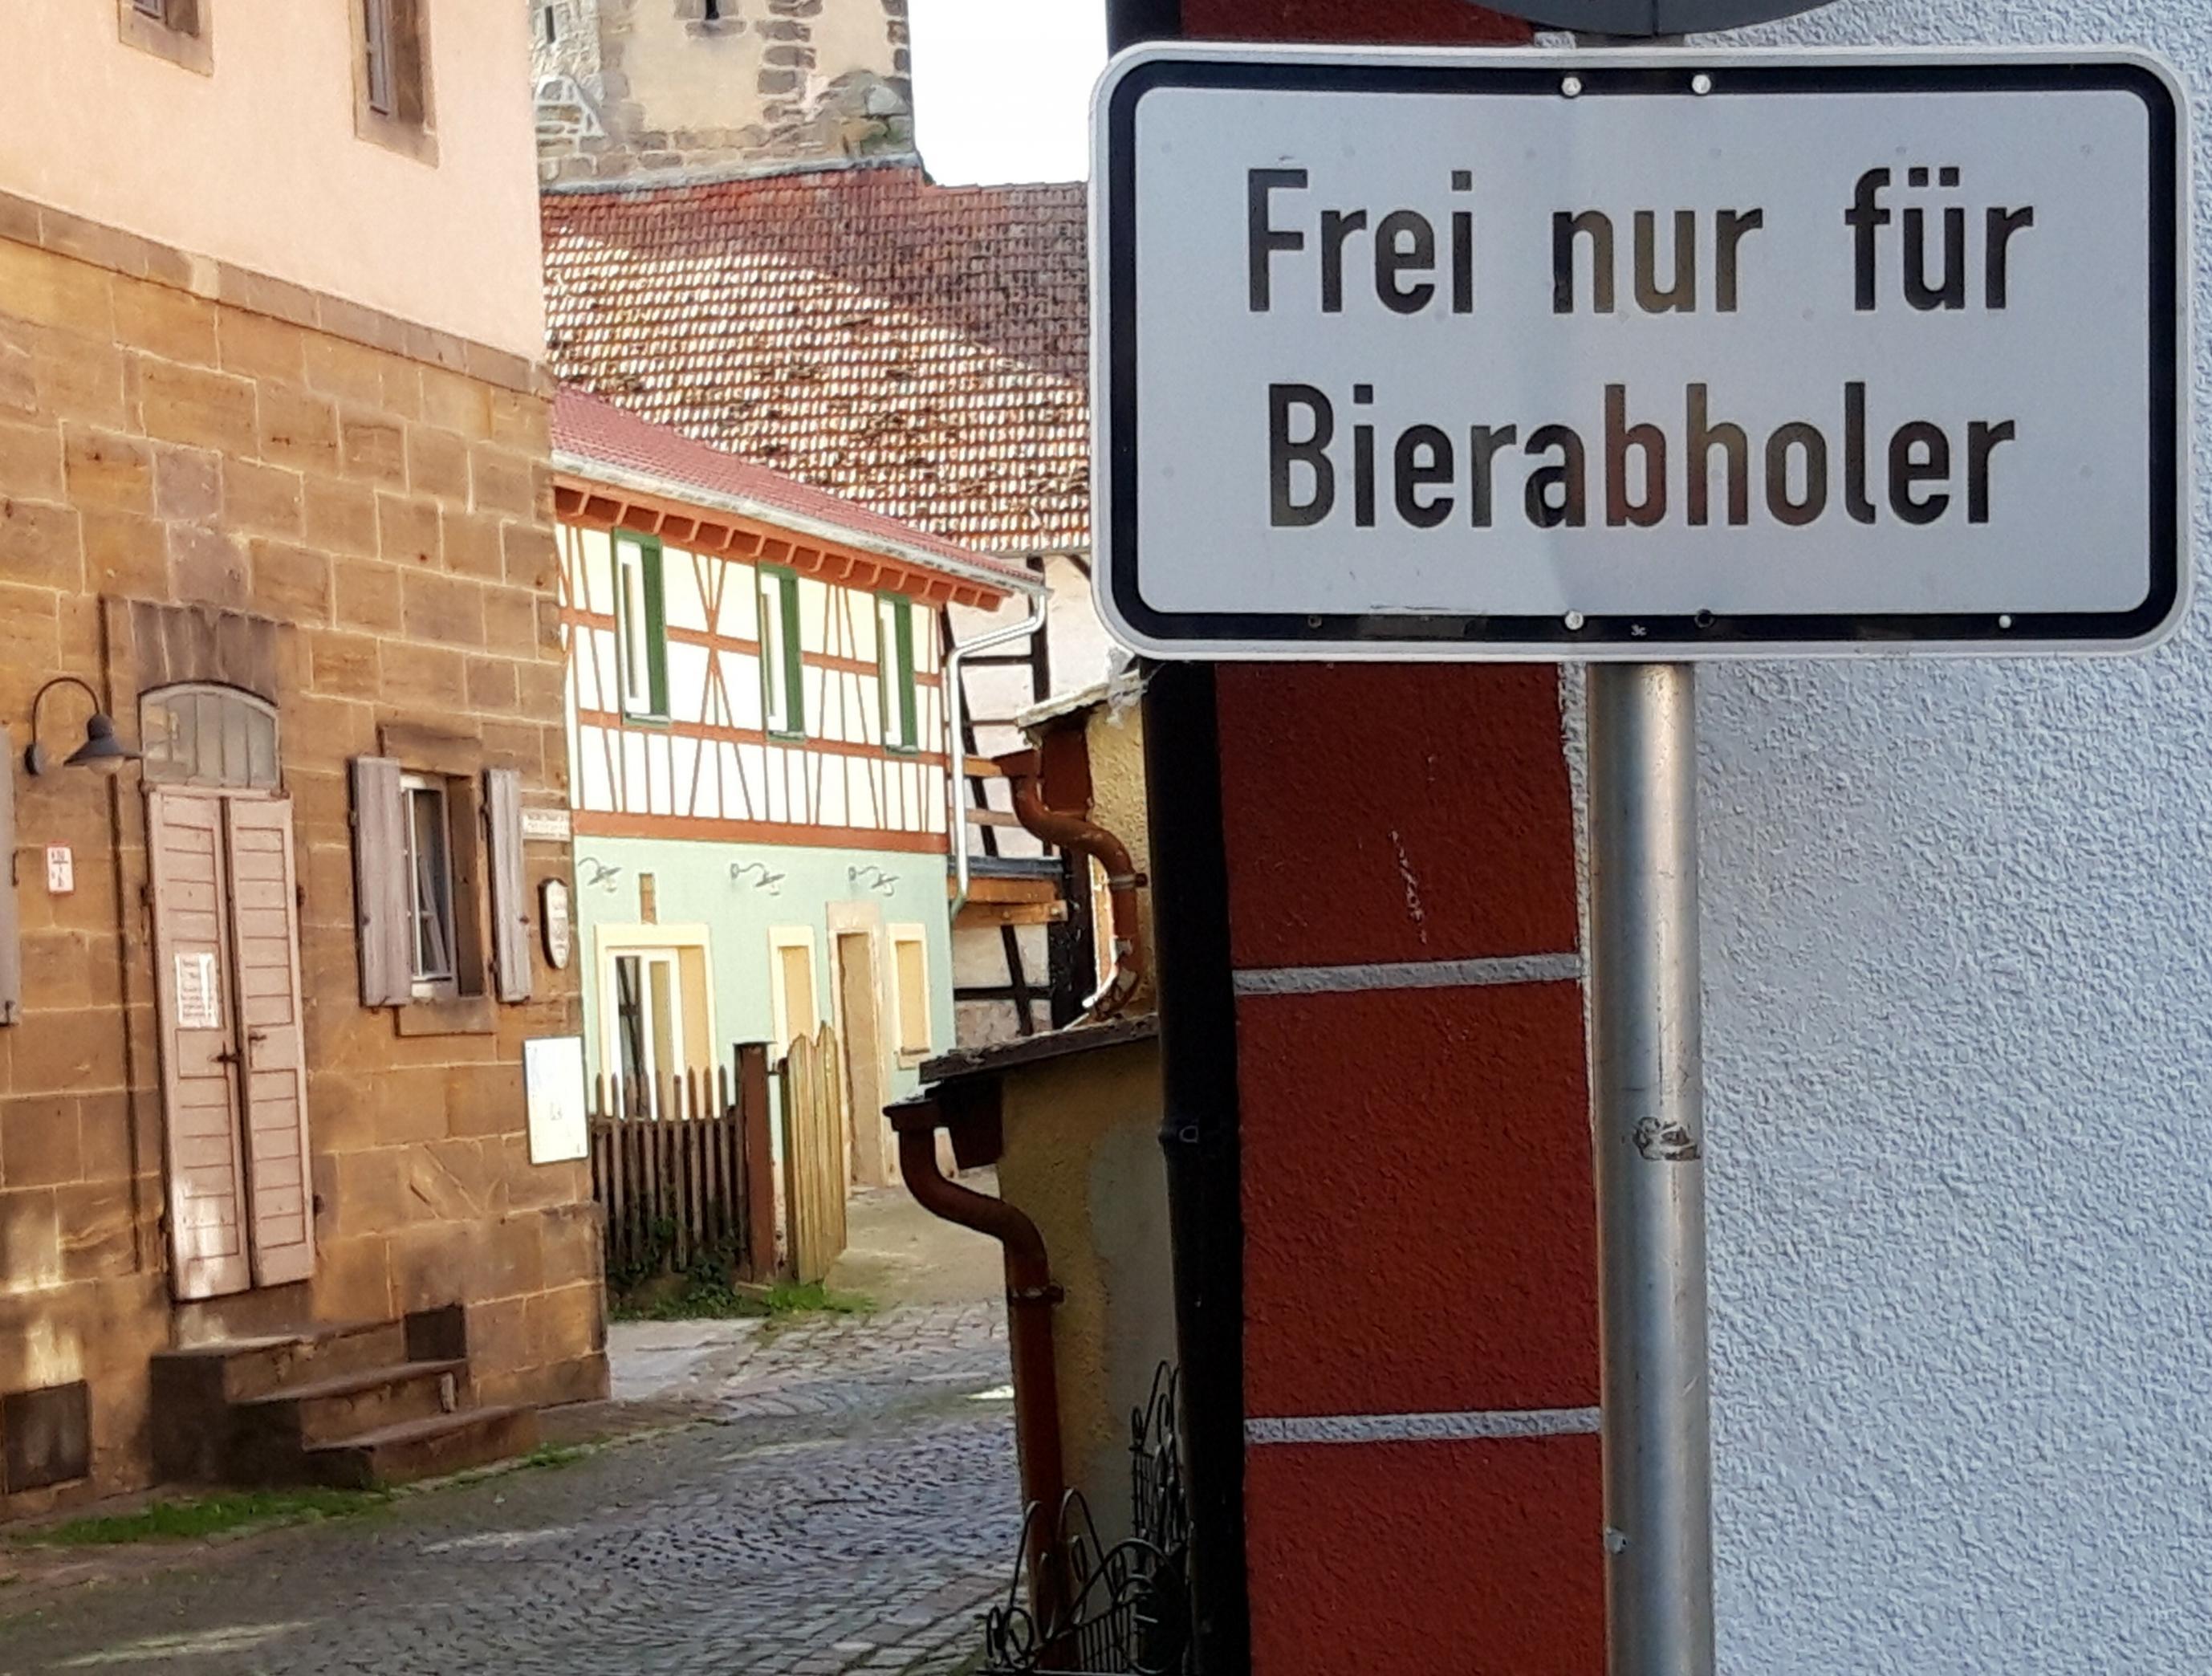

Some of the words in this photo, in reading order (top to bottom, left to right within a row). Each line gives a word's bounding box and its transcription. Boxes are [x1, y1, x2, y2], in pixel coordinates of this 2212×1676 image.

[1248, 168, 1473, 315] Frei
[1552, 210, 1763, 314] nur
[1844, 166, 2033, 311] für
[1269, 382, 2015, 529] Bierabholer
